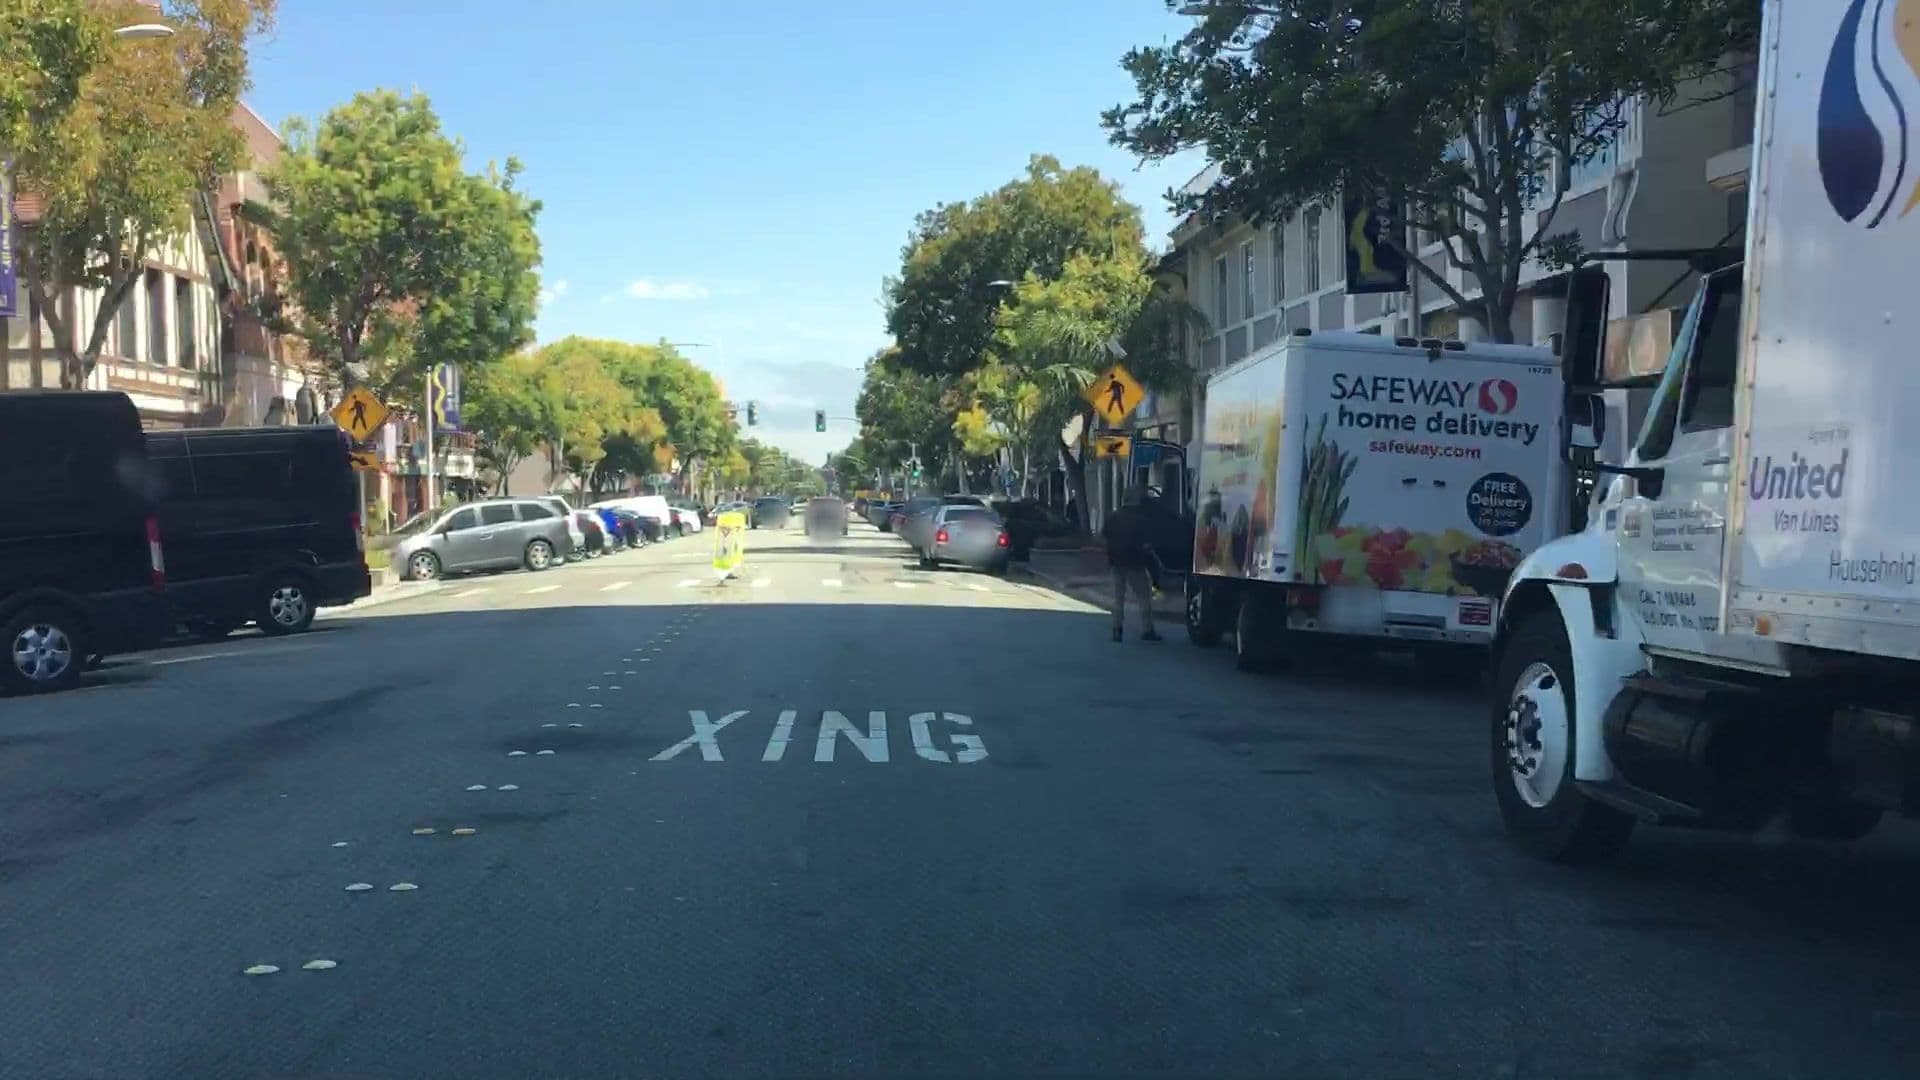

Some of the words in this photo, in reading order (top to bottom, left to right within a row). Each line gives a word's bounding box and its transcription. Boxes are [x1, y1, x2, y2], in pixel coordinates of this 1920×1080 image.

[1330, 372, 1474, 409] SAFEWAY
[1338, 404, 1417, 432] home
[1425, 410, 1540, 446] delivery
[1368, 439, 1481, 460] safeway.com
[1483, 480, 1517, 494] FREE
[1750, 448, 1849, 500] United
[1471, 492, 1527, 511] Delivery
[1774, 509, 1799, 532] Van
[1799, 509, 1841, 533] Lines
[1829, 549, 1917, 585] Household
[648, 709, 990, 763] XING
